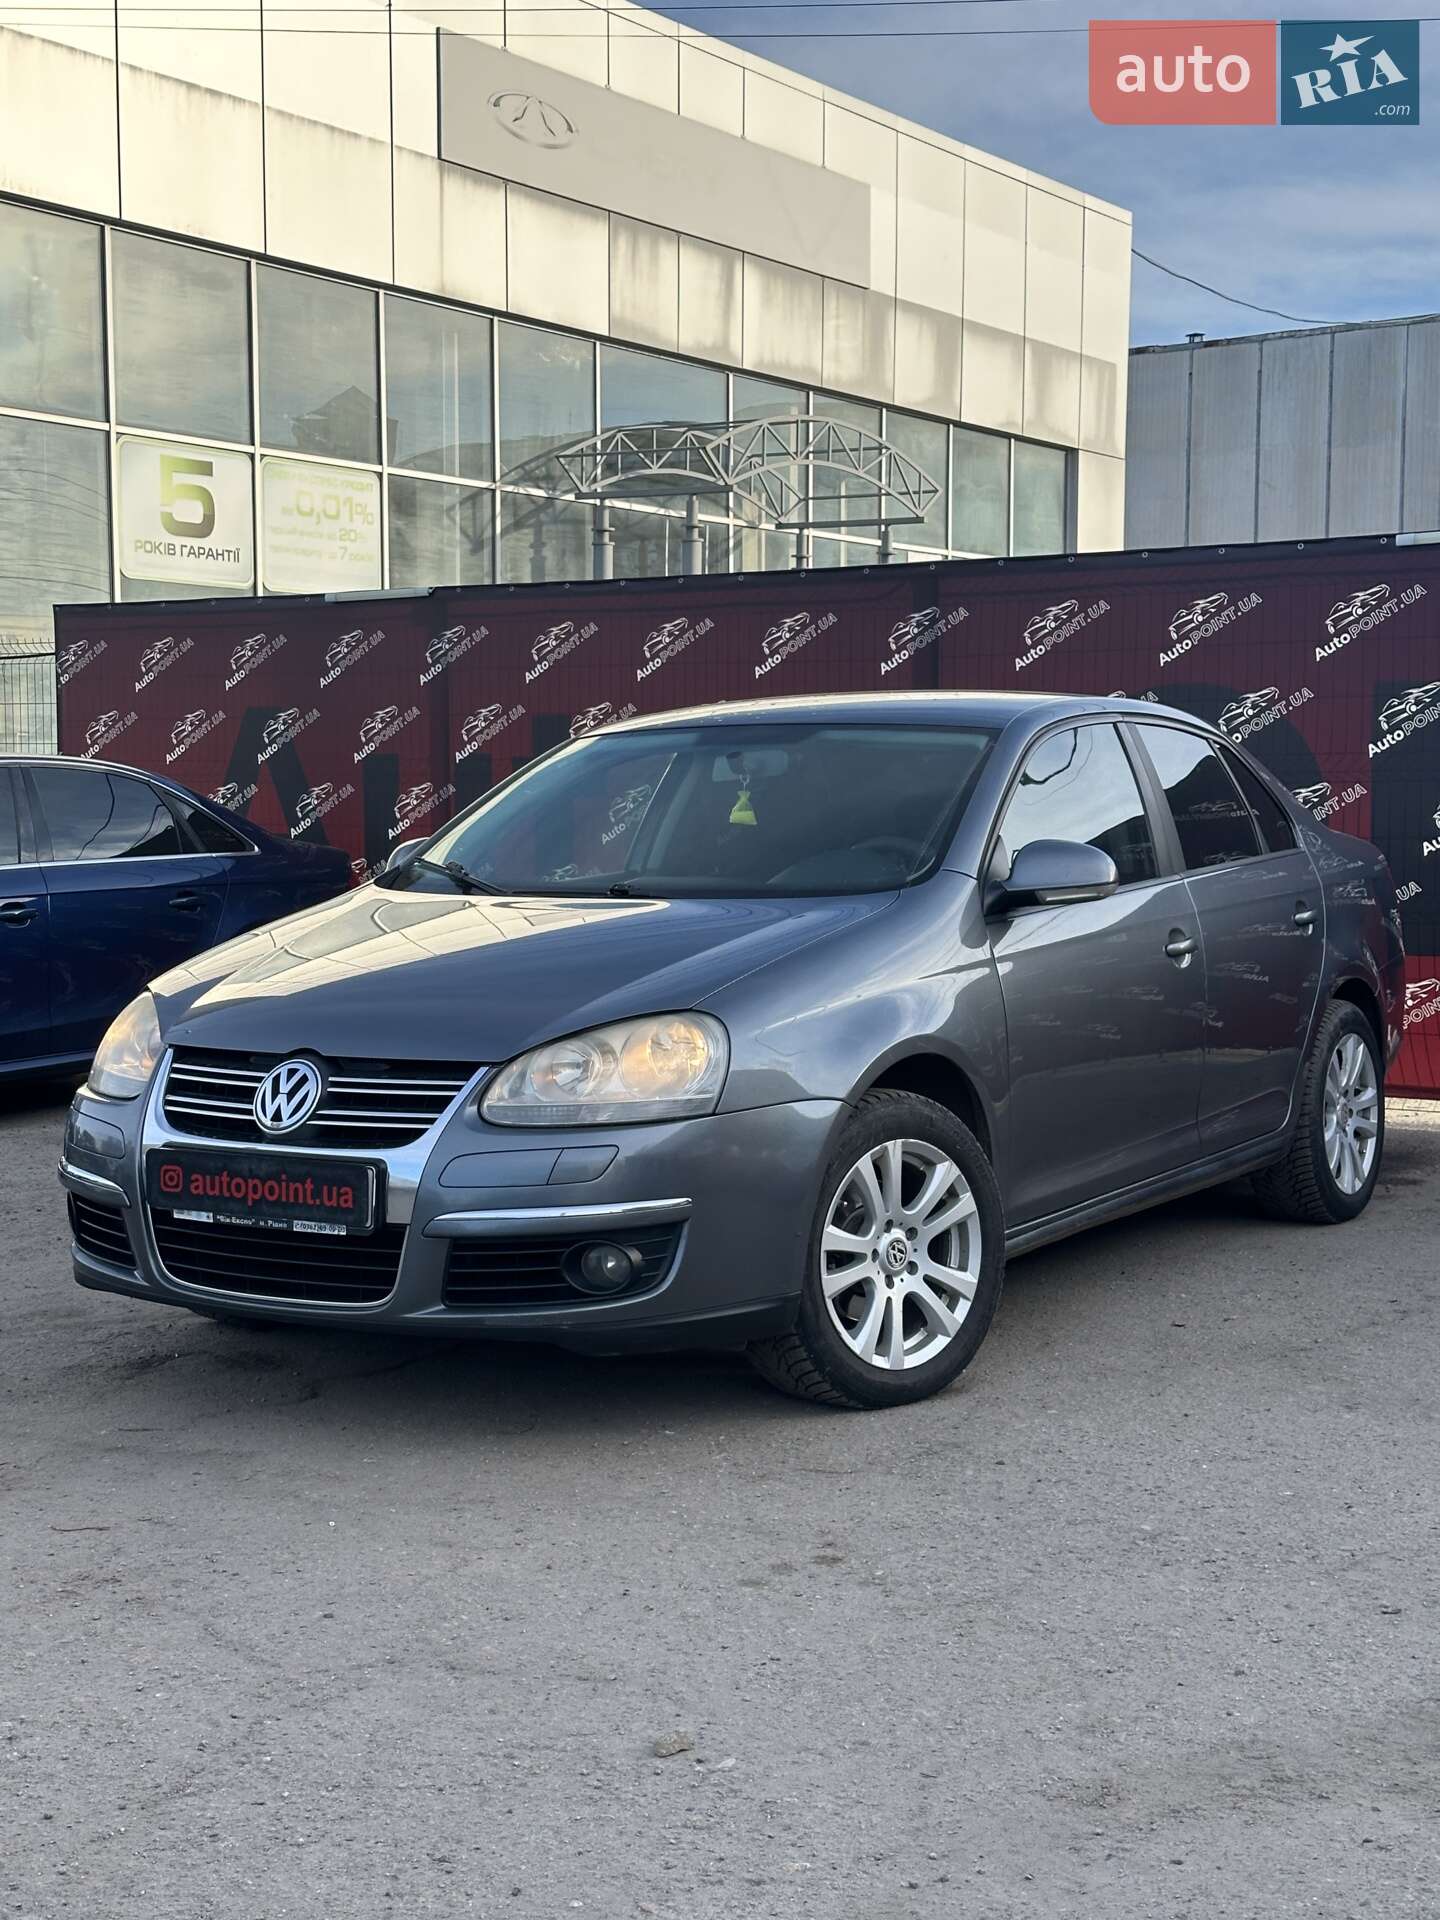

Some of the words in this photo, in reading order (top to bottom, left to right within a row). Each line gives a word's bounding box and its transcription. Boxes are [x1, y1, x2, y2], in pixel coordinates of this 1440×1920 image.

[159, 454, 216, 539] 5
[134, 539, 177, 556] РОКІВ
[180, 544, 241, 564] ГАРАНТІЇ
[1159, 592, 1263, 666] AutoPOINT.UA
[1314, 583, 1427, 662] AutoPOINT.UA
[190, 1170, 353, 1208] autopoint.ua
